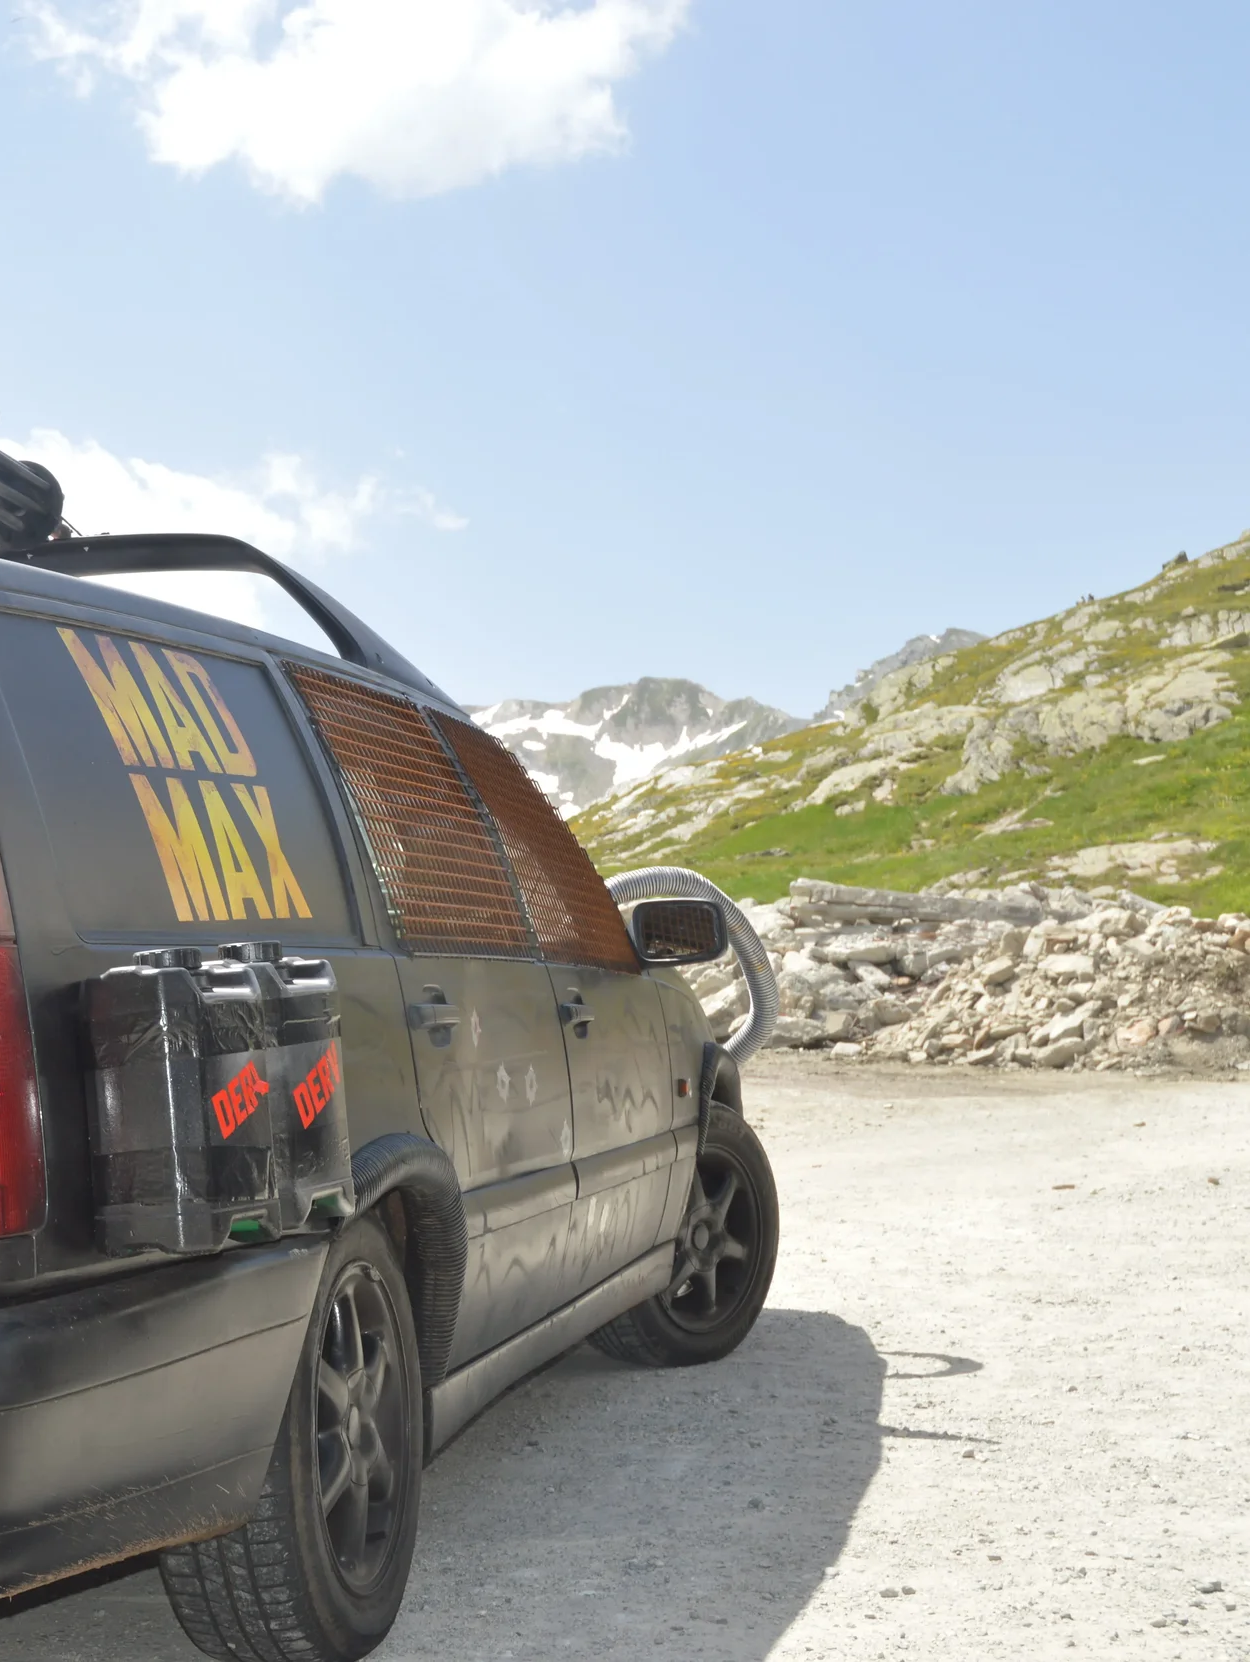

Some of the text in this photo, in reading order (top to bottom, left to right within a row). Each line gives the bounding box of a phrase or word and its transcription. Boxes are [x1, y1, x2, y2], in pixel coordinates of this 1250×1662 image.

[55, 626, 257, 777] MAD
[128, 773, 313, 922] MAX
[292, 1040, 341, 1130] DERV
